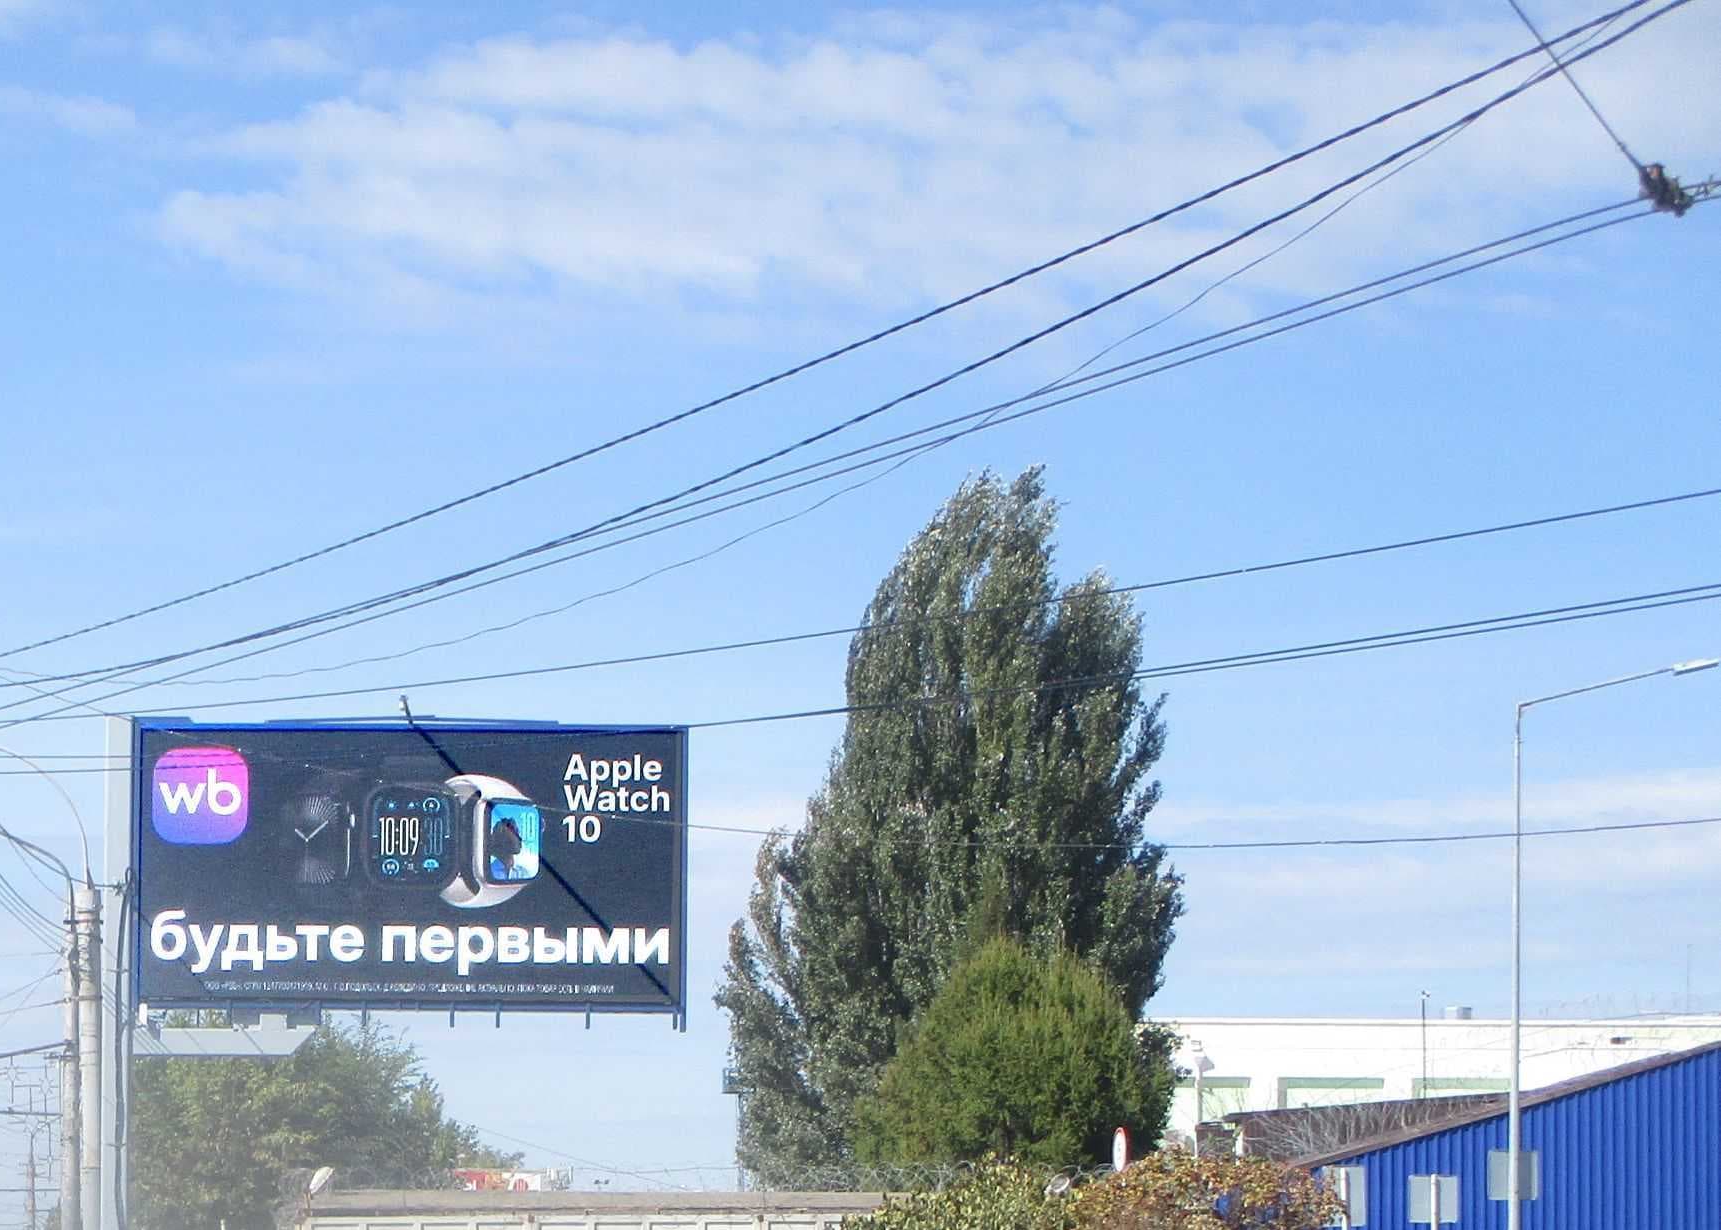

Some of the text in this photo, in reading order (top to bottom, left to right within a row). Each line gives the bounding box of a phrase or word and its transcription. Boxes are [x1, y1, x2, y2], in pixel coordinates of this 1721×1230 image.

[563, 754, 663, 787] Apple
[159, 768, 242, 815] wb
[564, 785, 670, 813] Watch
[379, 817, 419, 855] 10:09
[562, 815, 601, 843] 10
[150, 909, 669, 976] будьте первыми
